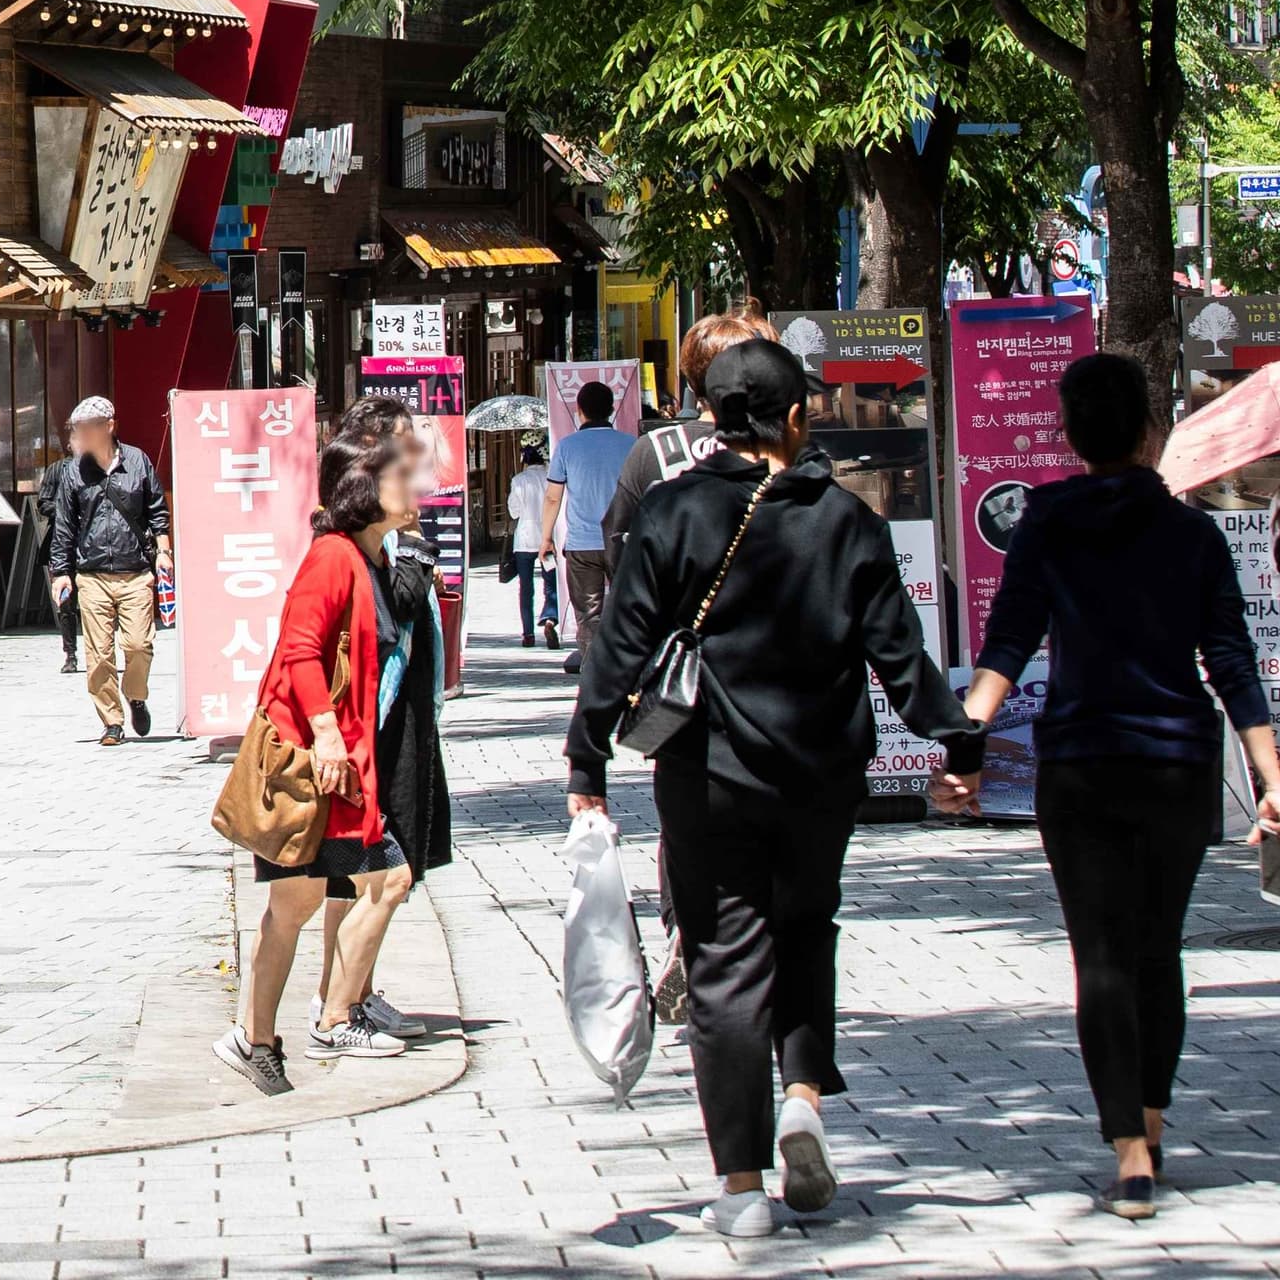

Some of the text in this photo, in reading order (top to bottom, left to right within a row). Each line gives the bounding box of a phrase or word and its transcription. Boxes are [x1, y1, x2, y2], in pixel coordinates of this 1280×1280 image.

[375, 315, 405, 334] 안경
[378, 340, 442, 352] 50% SALE
[1018, 350, 1032, 358] Ring
[1030, 360, 1073, 373] 어떤 곳일
[417, 378, 459, 413] 1+1
[195, 397, 295, 438] 신성
[971, 414, 1000, 428] 恋人
